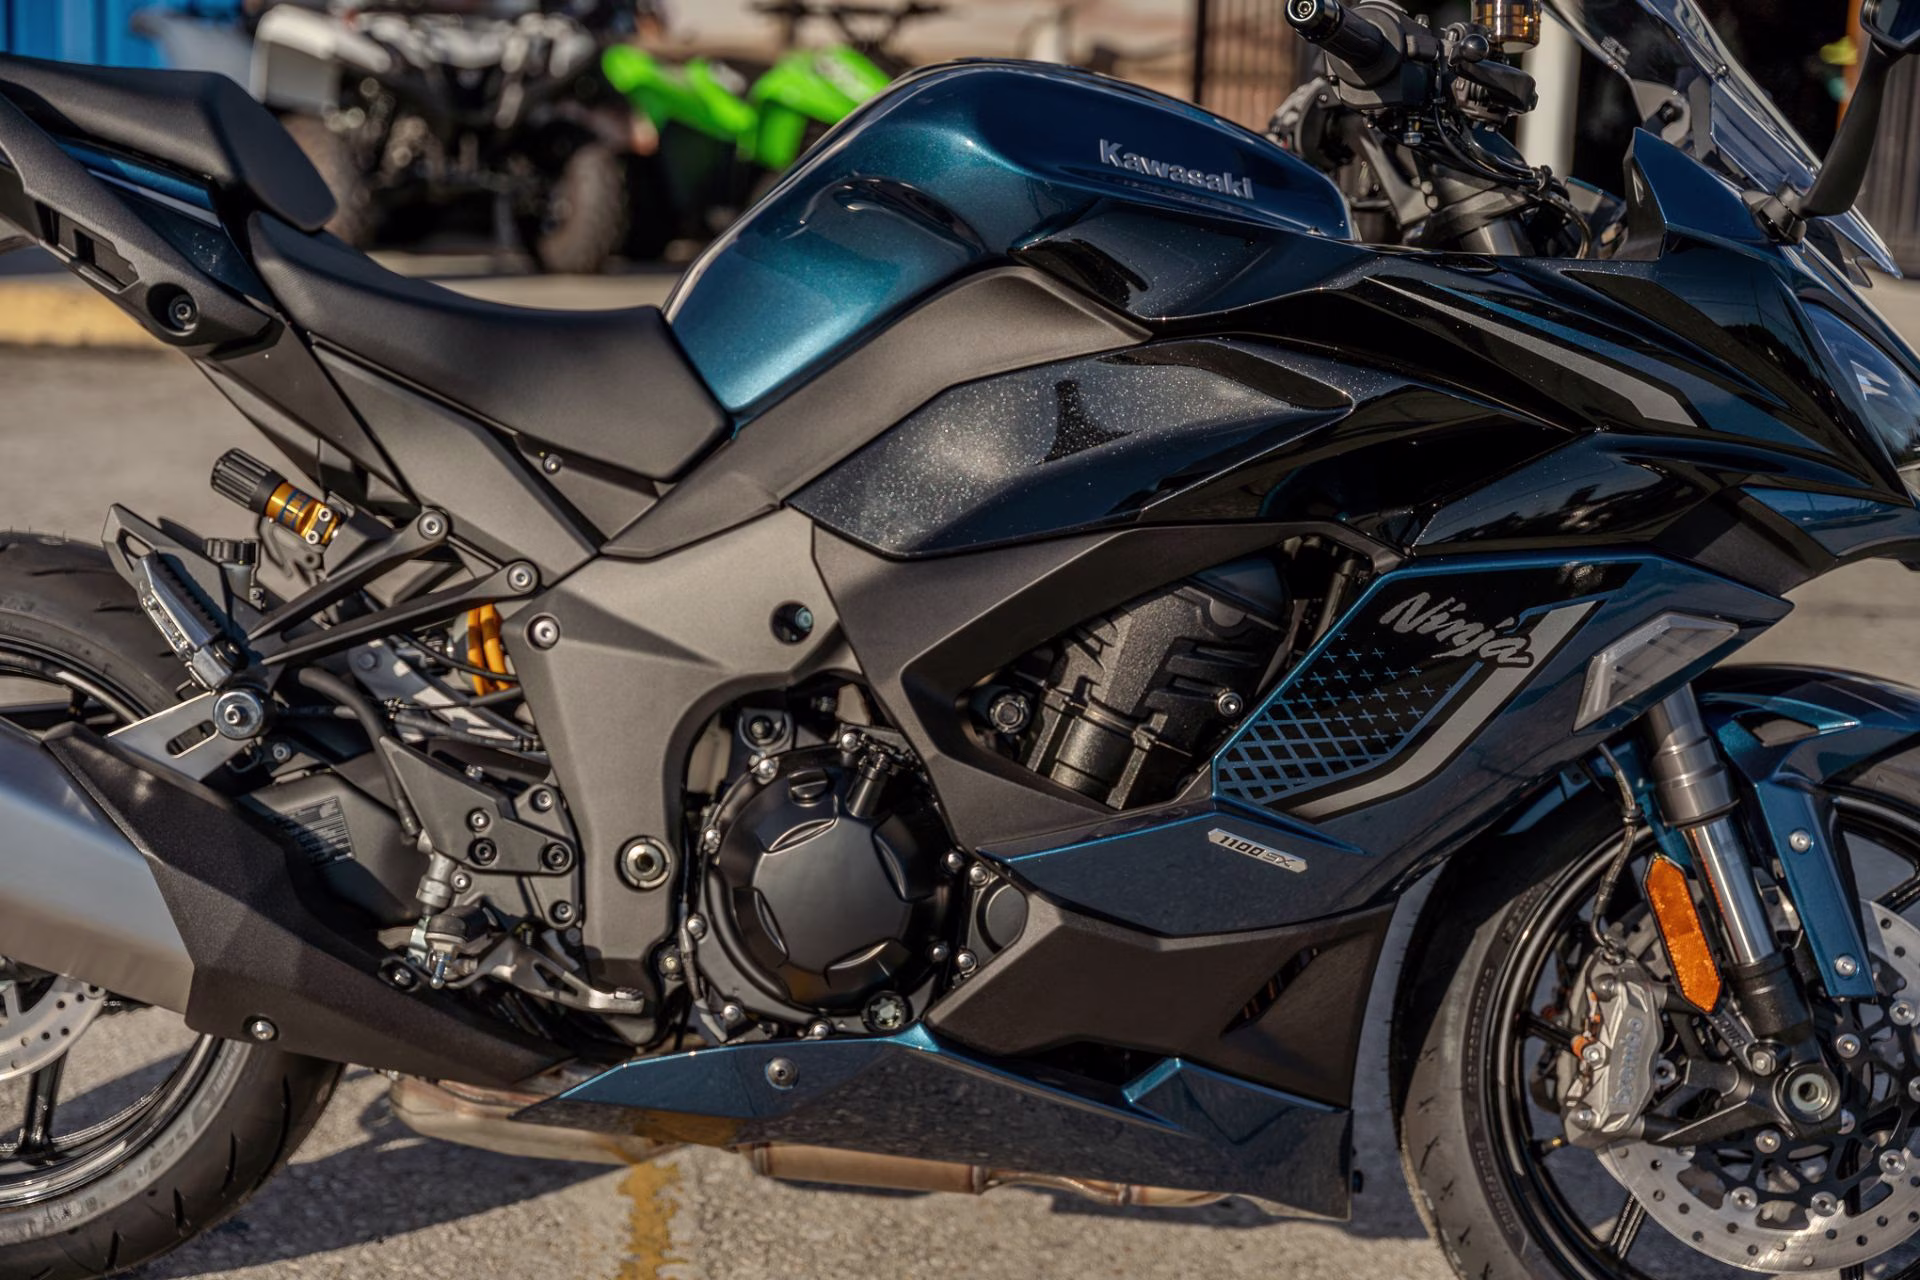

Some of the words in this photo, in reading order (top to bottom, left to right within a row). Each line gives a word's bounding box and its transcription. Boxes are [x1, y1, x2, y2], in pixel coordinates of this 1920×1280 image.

[1100, 138, 1255, 200] Kawasaki
[1378, 591, 1530, 664] Ninja
[1219, 835, 1296, 868] 1100SX
